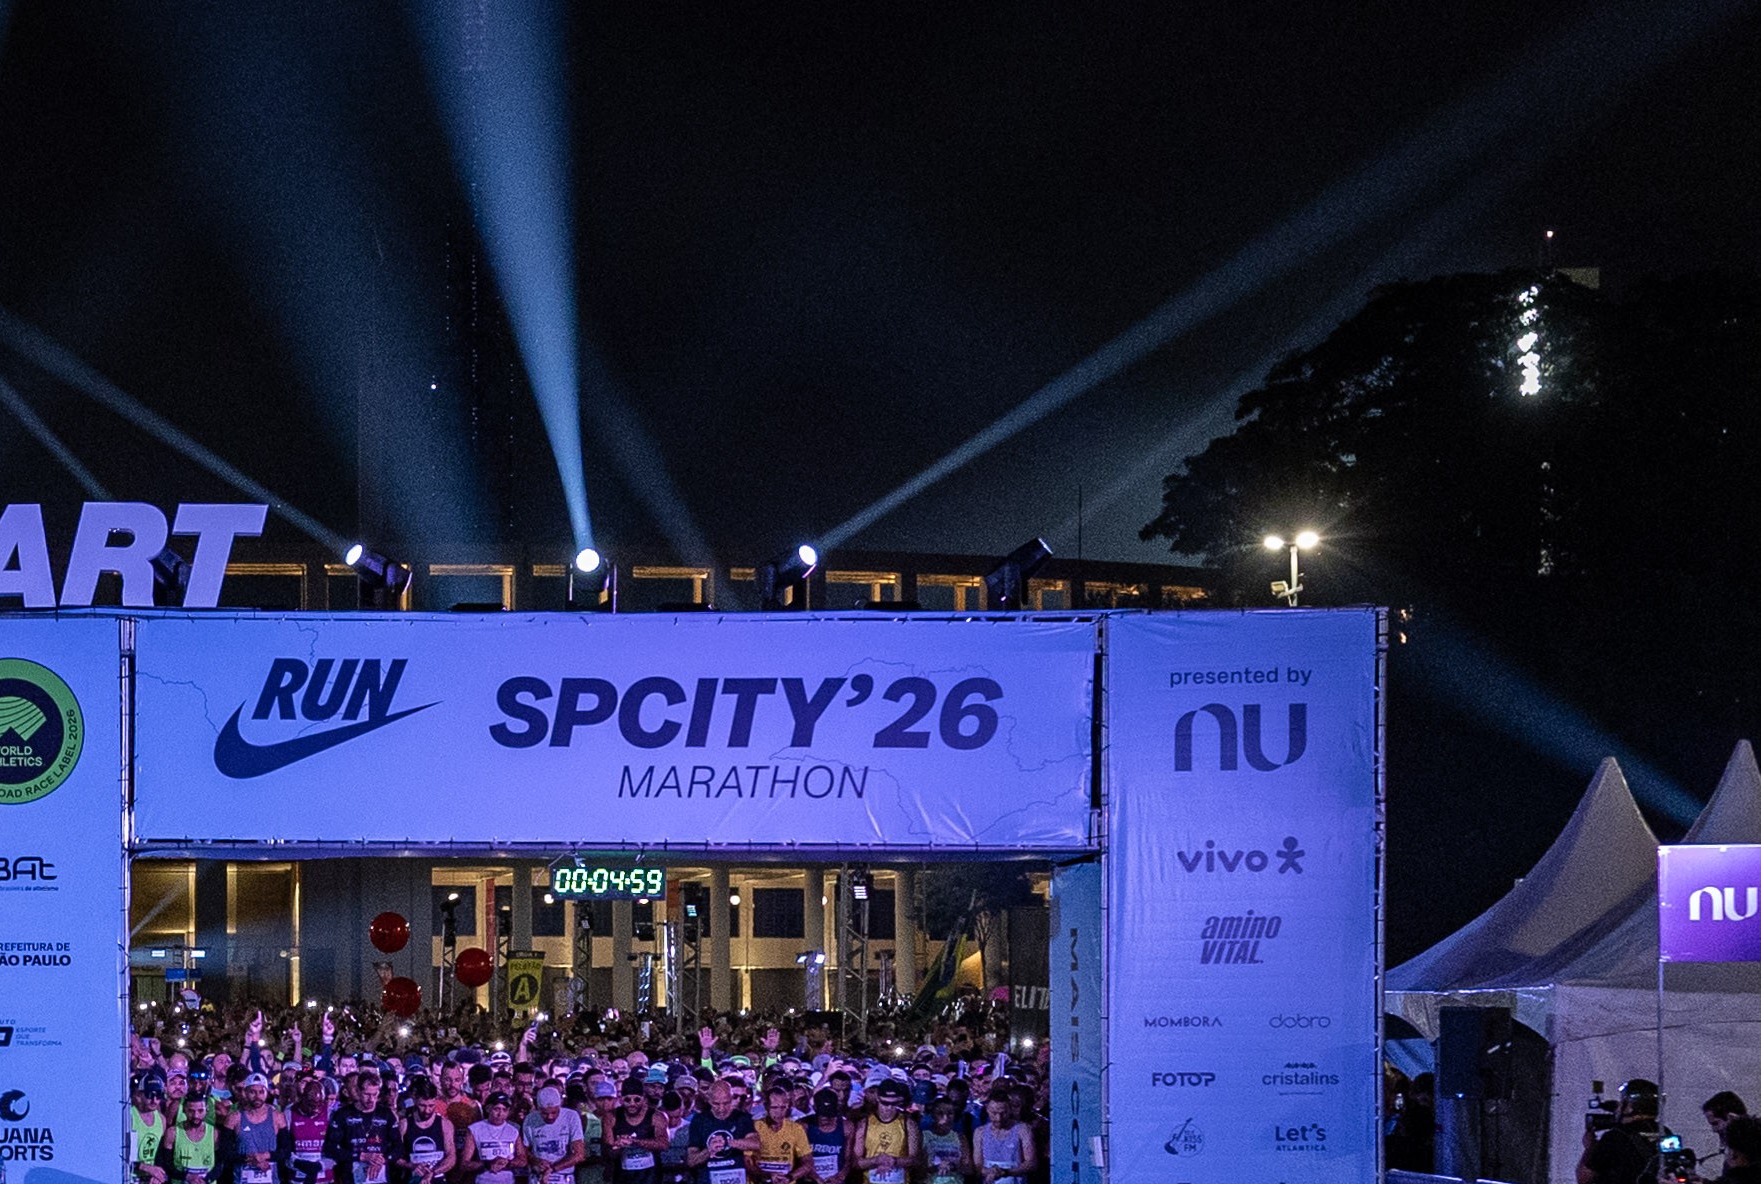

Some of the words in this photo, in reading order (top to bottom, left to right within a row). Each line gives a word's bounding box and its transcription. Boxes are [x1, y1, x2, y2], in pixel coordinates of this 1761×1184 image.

[251, 657, 408, 722] RUN
[1170, 667, 1279, 688] presented
[1287, 667, 1312, 687] by
[488, 673, 1004, 751] SPCITY'26
[1174, 703, 1308, 772] nu
[25, 776, 54, 796] RACE
[53, 744, 76, 778] LABEL
[66, 709, 78, 740] 2026
[618, 765, 869, 799] MARATHON
[1177, 839, 1269, 873] vivo
[554, 868, 663, 894] 00:04:59
[1689, 887, 1759, 921] nu
[1201, 909, 1282, 939] amino
[56, 942, 70, 951] DE
[23, 955, 71, 966] PAULO
[514, 977, 530, 1001] A
[1144, 1016, 1223, 1028] MOMBORA
[1269, 1013, 1331, 1029] dobro
[1152, 1072, 1216, 1086] FOTOP
[1262, 1071, 1340, 1086] cristalins
[1275, 1123, 1327, 1142] Let's
